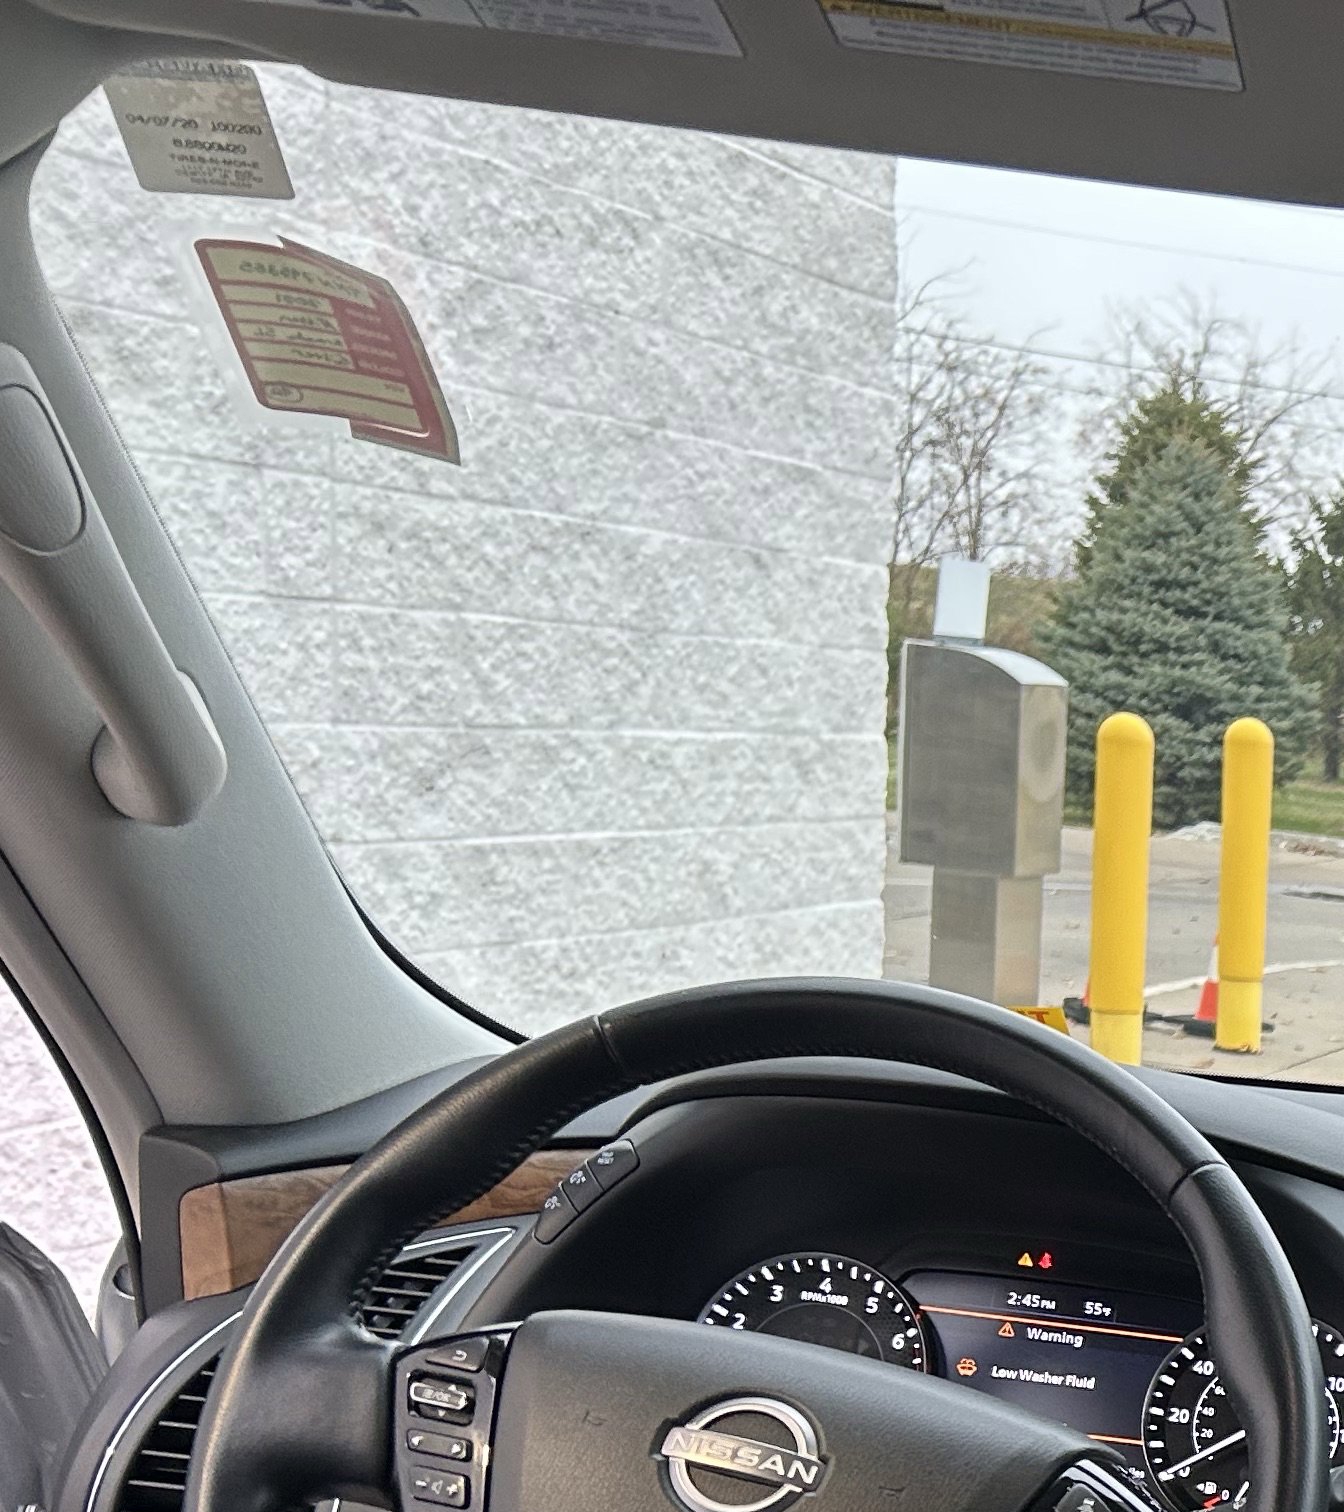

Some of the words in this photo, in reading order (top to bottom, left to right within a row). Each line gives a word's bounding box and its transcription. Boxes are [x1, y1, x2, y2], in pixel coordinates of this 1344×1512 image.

[769, 1285, 784, 1302] 3
[819, 1278, 832, 1294] 4
[865, 1297, 879, 1314] 5
[733, 1313, 745, 1329] 2
[891, 1333, 905, 1350] 6
[1026, 1327, 1084, 1348] Warning
[1192, 1360, 1215, 1376] 40
[991, 1365, 1018, 1380] Low
[1019, 1368, 1064, 1385] Washer
[1066, 1374, 1096, 1390] Fluid
[1168, 1408, 1190, 1424] 20
[1201, 1407, 1215, 1417] 40
[1201, 1428, 1213, 1438] 20
[671, 1432, 819, 1485] NISSAN
